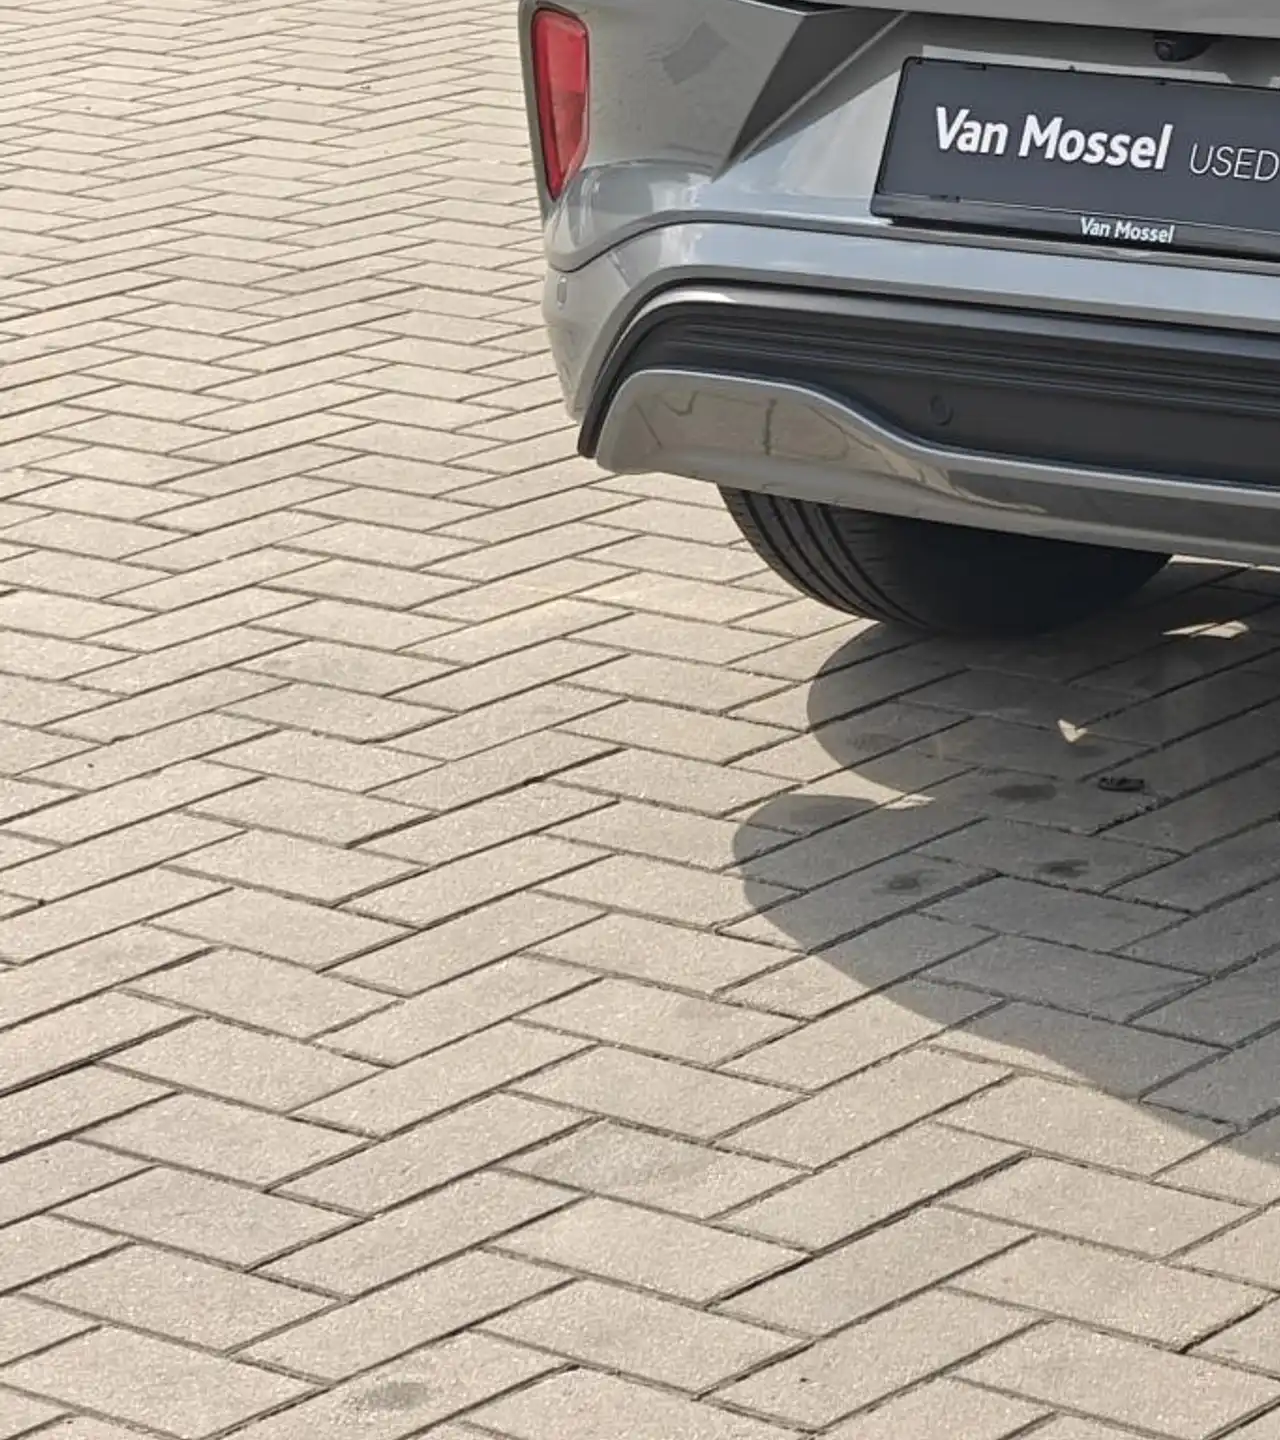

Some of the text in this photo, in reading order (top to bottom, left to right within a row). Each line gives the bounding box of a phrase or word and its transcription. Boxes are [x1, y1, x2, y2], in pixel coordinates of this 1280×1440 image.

[935, 105, 1008, 155] Van
[1018, 114, 1174, 171] Mossel
[1189, 143, 1280, 182] USED
[1080, 216, 1176, 244] Van Mossel
